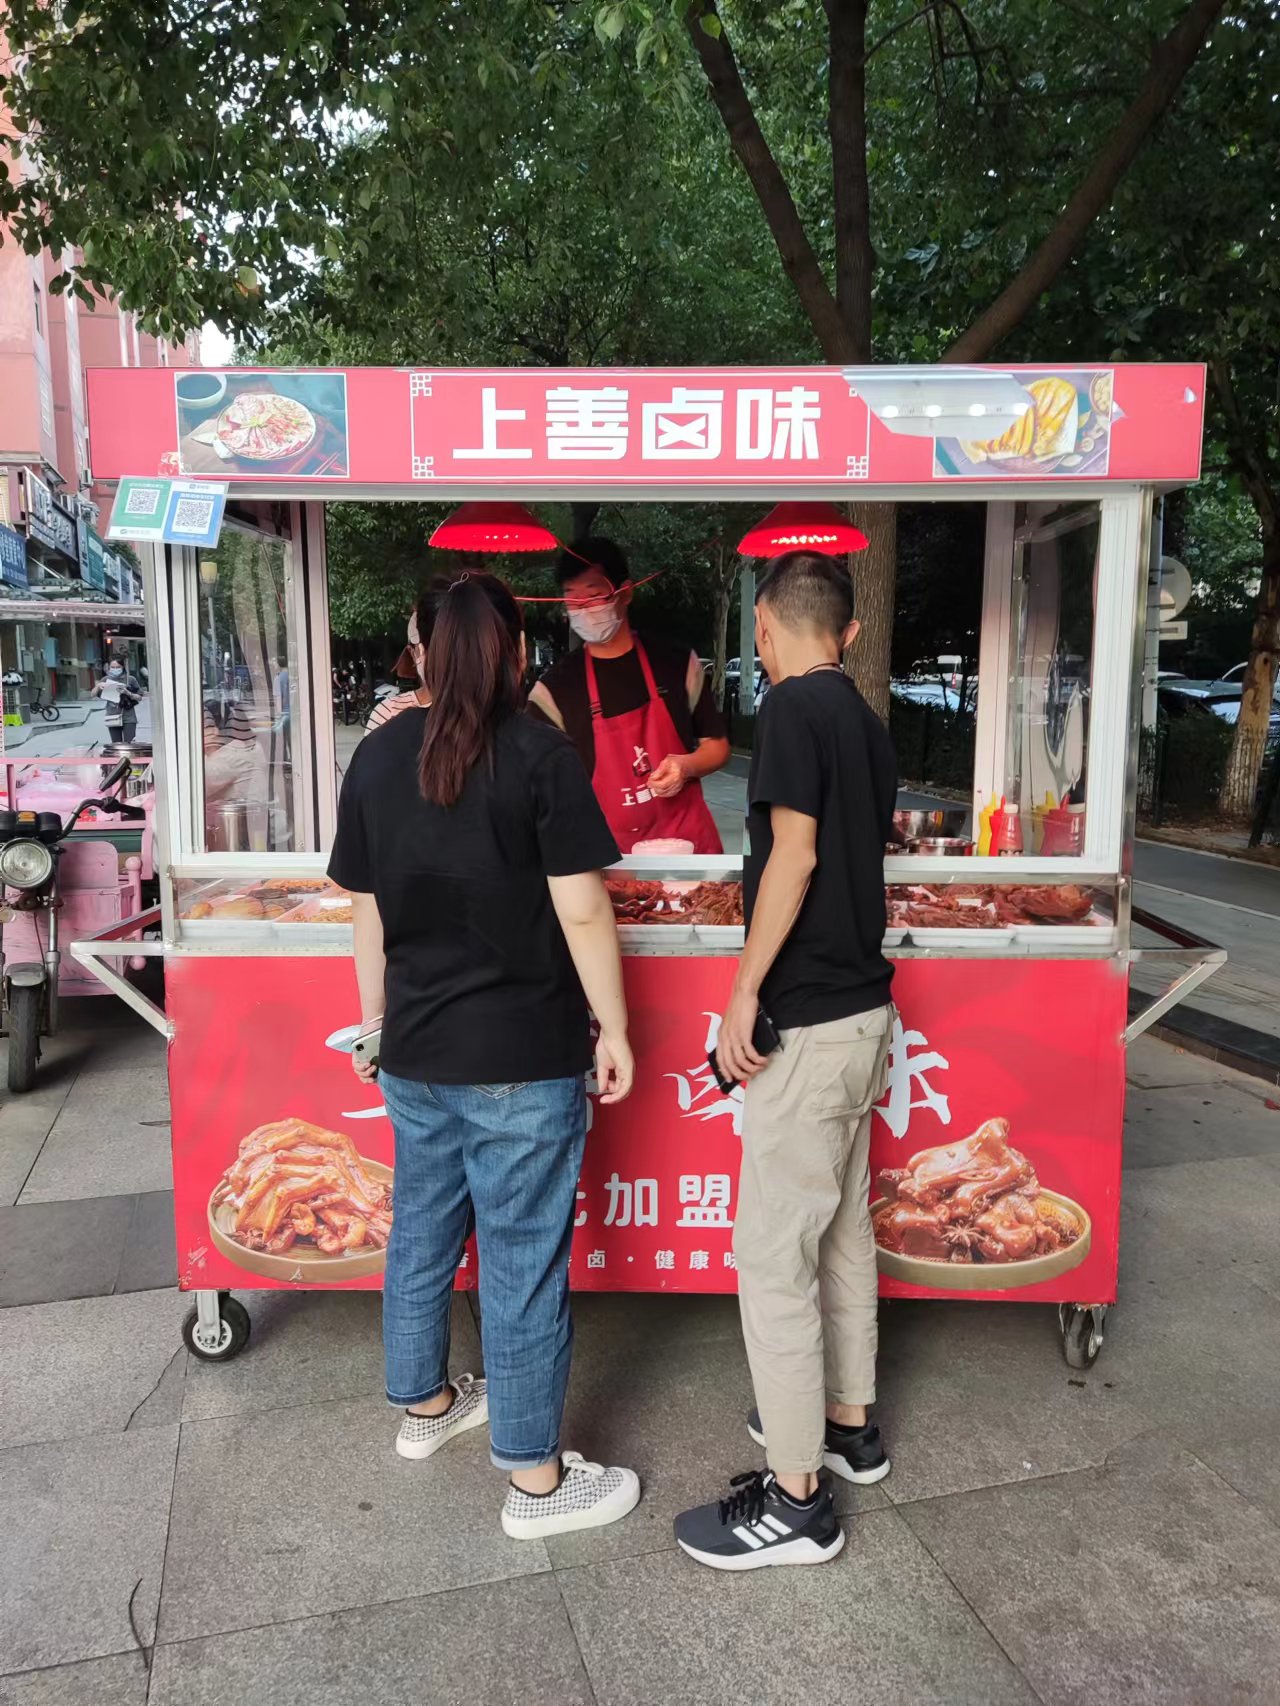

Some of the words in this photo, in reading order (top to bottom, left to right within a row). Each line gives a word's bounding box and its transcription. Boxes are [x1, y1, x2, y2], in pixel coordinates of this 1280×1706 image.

[453, 386, 820, 460] 上善卤味
[573, 1172, 734, 1228] 加盟
